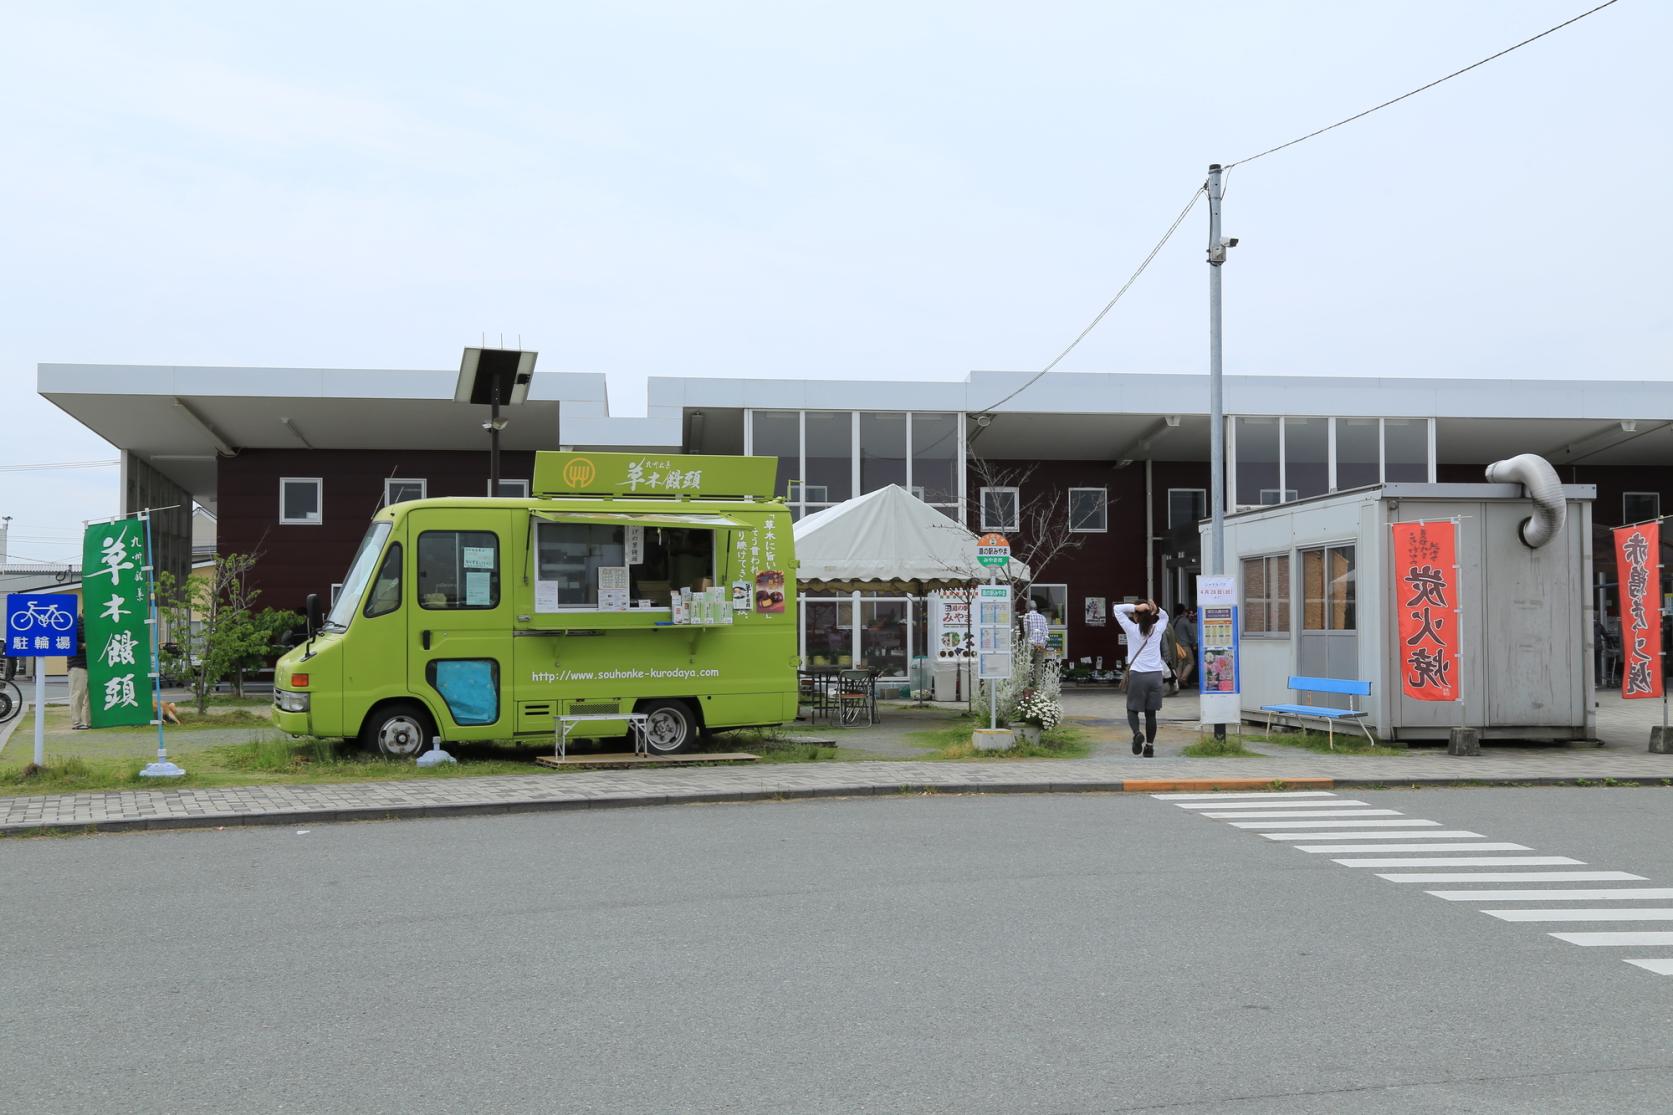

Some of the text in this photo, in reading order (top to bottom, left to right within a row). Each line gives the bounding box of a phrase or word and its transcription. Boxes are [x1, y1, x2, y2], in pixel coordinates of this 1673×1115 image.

[12, 636, 71, 650] 駐輪場
[532, 667, 720, 683] http://www.souhonke-kurodaya.com
